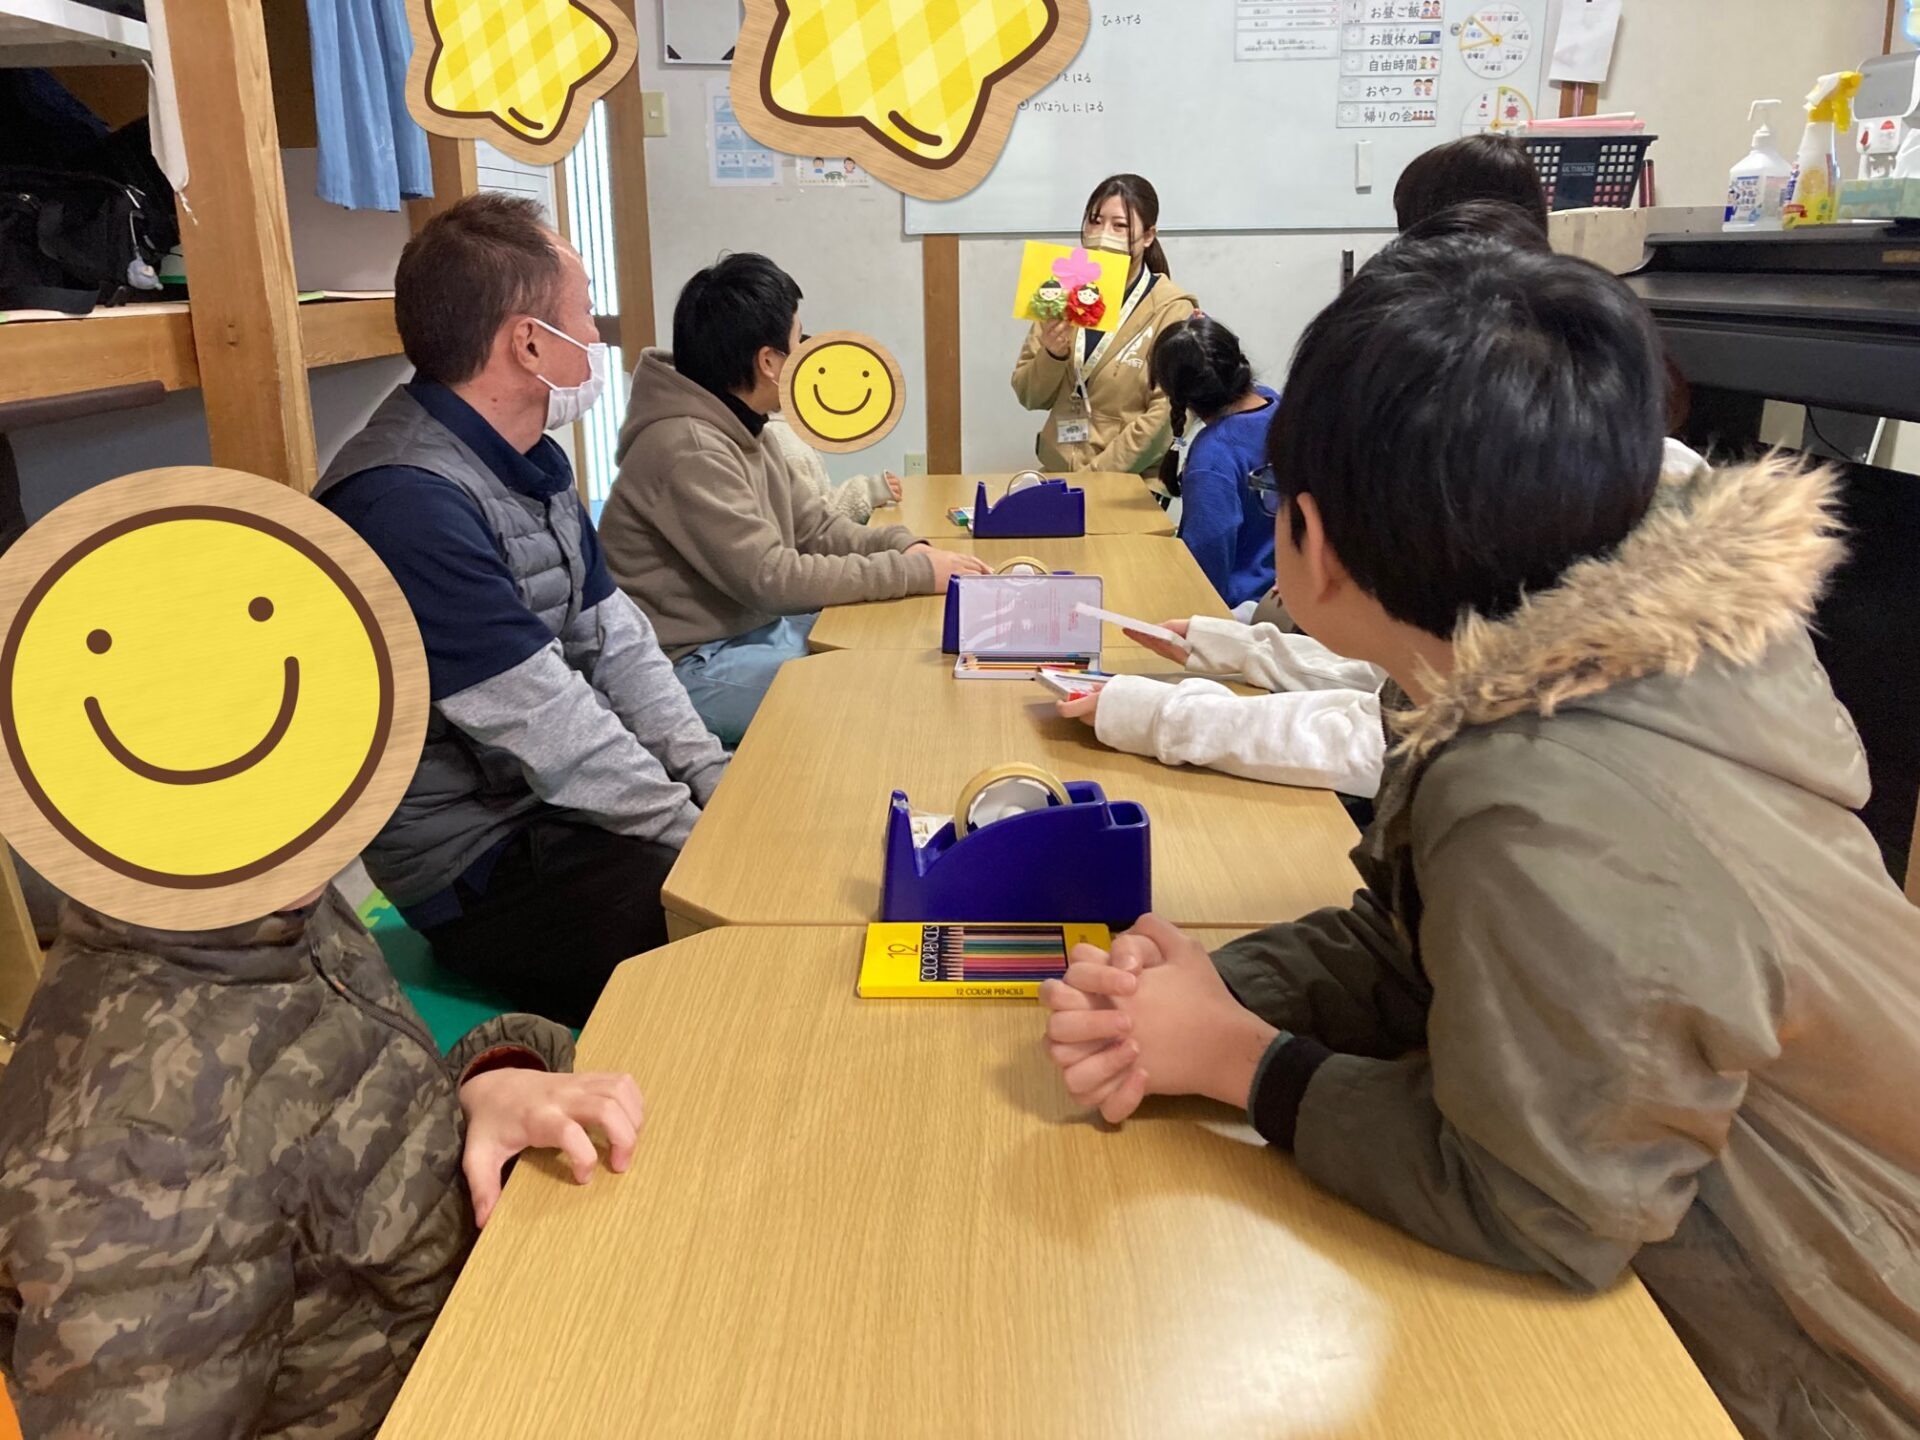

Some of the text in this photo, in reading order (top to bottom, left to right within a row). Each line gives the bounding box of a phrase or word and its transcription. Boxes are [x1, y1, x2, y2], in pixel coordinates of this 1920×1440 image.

[1370, 6, 1420, 19] お昼ご飯
[1101, 14, 1142, 27] ひろげる
[1369, 32, 1419, 46] お腹休め
[1369, 59, 1418, 72] 自由時間
[1366, 85, 1403, 98] おやつ
[1363, 110, 1413, 123] 帰りの会
[887, 943, 919, 959] 12
[921, 953, 939, 981] COLOR
[955, 987, 1024, 996] 12 COLOR PENCILS
